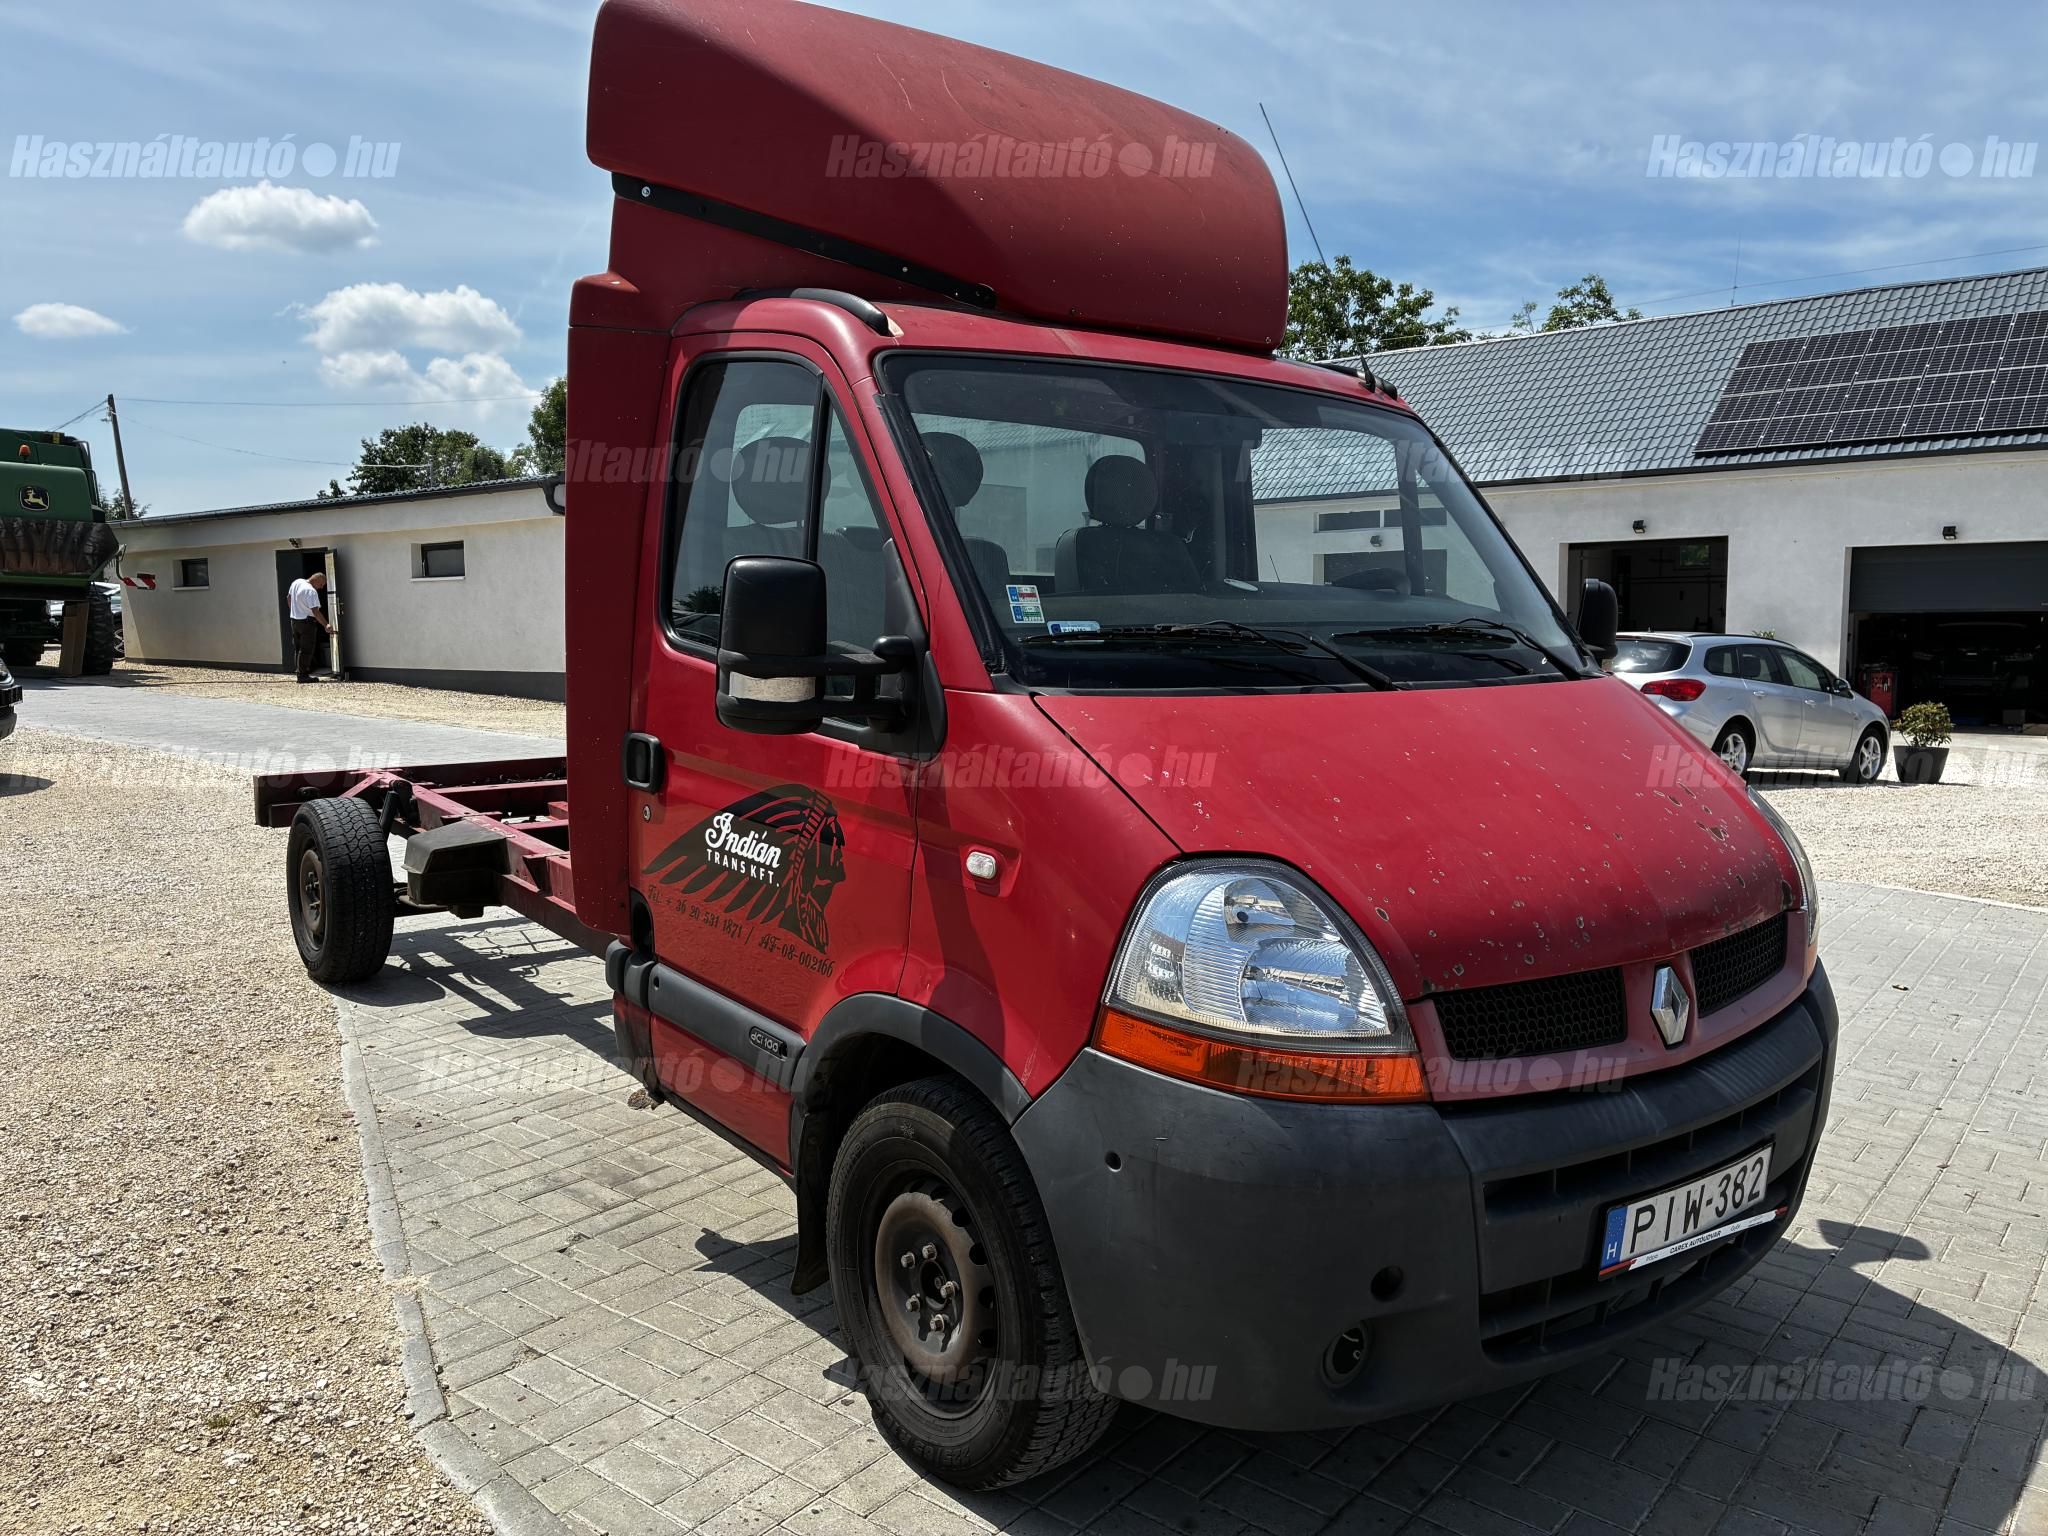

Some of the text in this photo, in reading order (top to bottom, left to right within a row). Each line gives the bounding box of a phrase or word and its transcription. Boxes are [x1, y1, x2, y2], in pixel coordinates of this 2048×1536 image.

[705, 812, 781, 868] Indián
[706, 849, 779, 887] TRANS KFT.
[676, 899, 687, 914] 36
[689, 905, 700, 921] 20
[703, 912, 719, 928] 531
[722, 919, 743, 938] 1871
[764, 1037, 778, 1053] 100
[1630, 1157, 1764, 1254] PIW-382
[1607, 1242, 1617, 1260] H
[1669, 1243, 1689, 1254] CAREX
